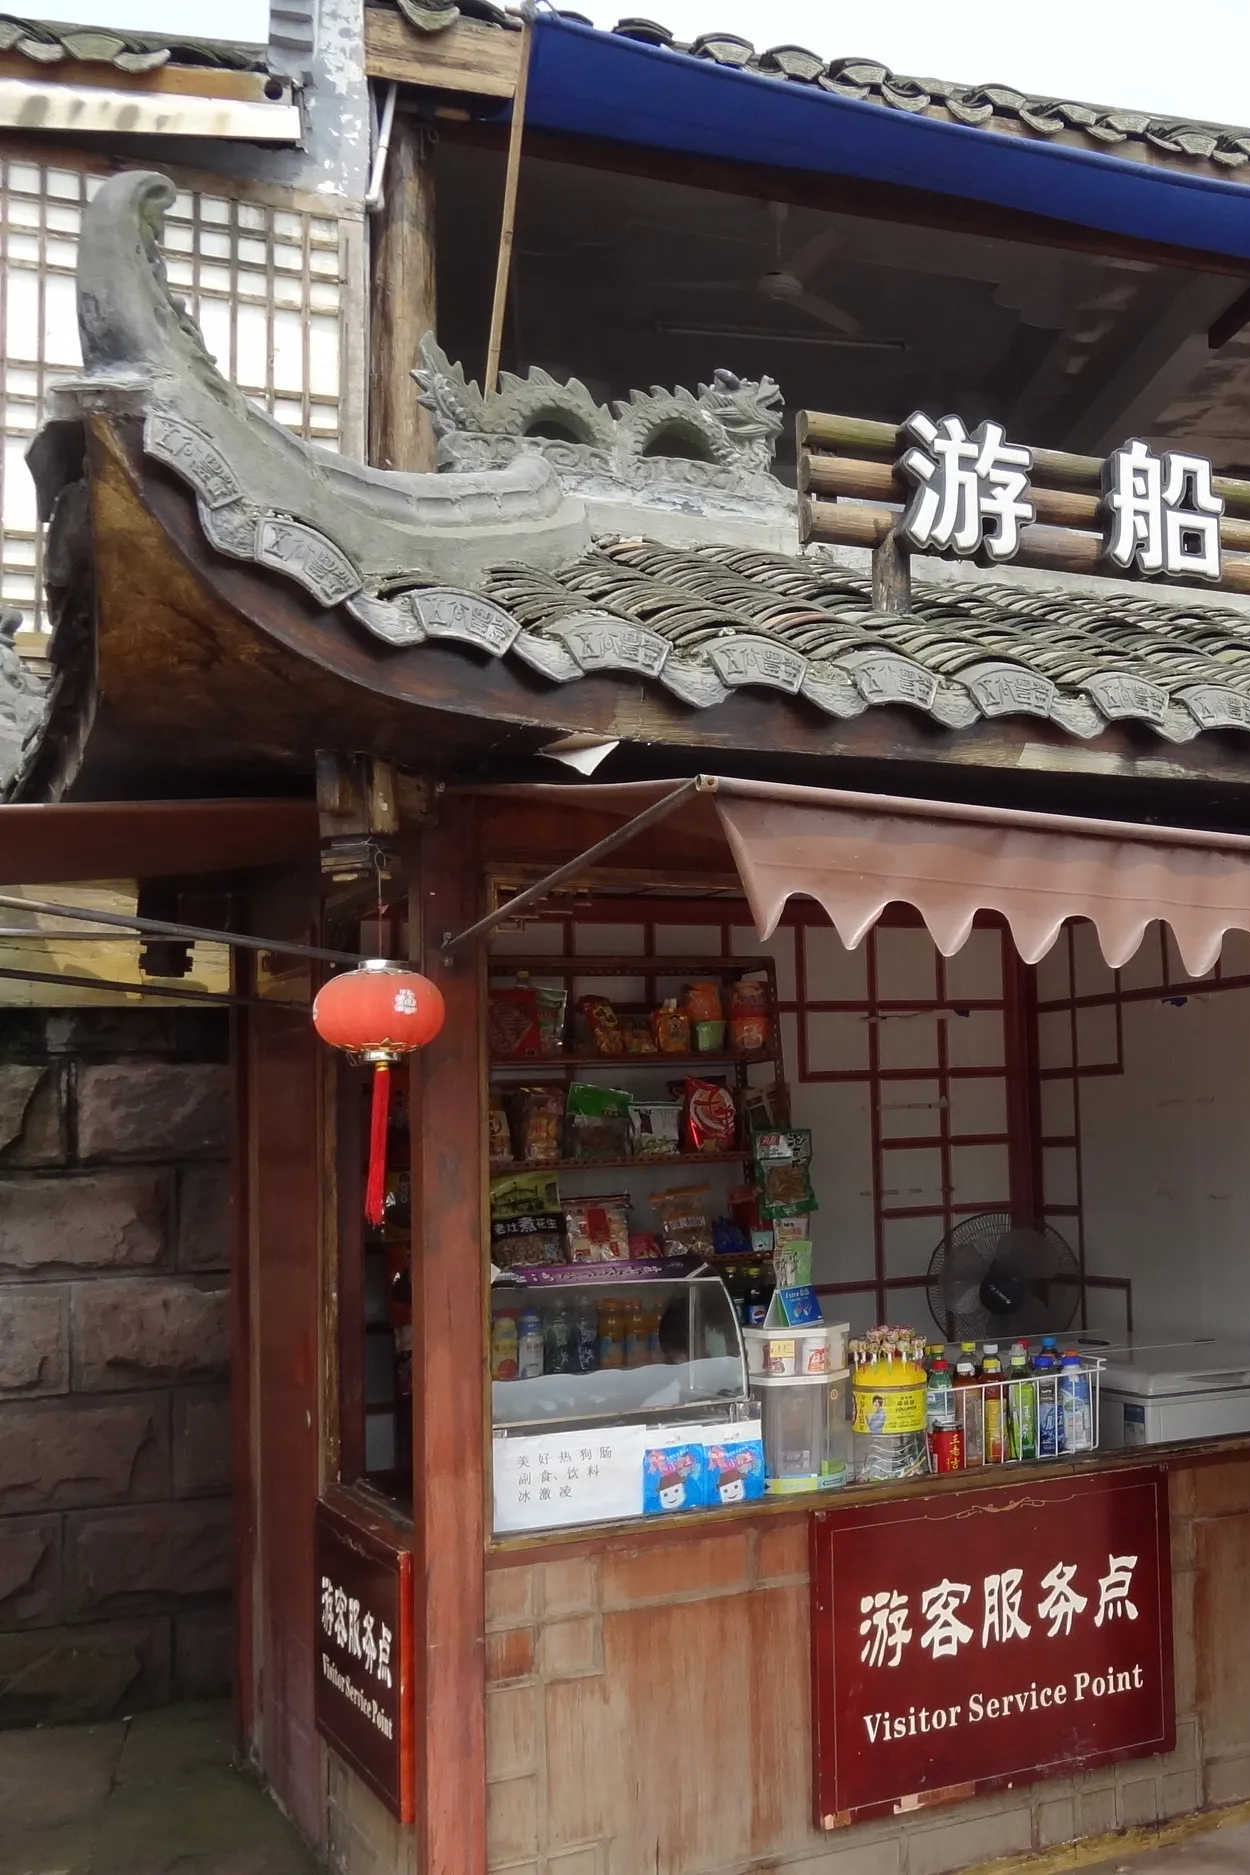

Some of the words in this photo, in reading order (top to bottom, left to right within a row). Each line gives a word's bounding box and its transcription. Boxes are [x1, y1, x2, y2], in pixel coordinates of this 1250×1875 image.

[516, 1445, 613, 1469] 美好热狗肠
[518, 1464, 601, 1486] 副食、饮料
[949, 1434, 961, 1470] 王老吉
[517, 1484, 573, 1503] 冰激凌
[320, 1575, 393, 1689] 游客服务点
[859, 1553, 1139, 1668] 游客服务点
[321, 1652, 346, 1695] Visitor
[345, 1676, 372, 1720] Service
[372, 1700, 394, 1740] Point
[864, 1702, 961, 1744] Visitor
[968, 1684, 1067, 1723] Service
[1073, 1663, 1144, 1702] Point
